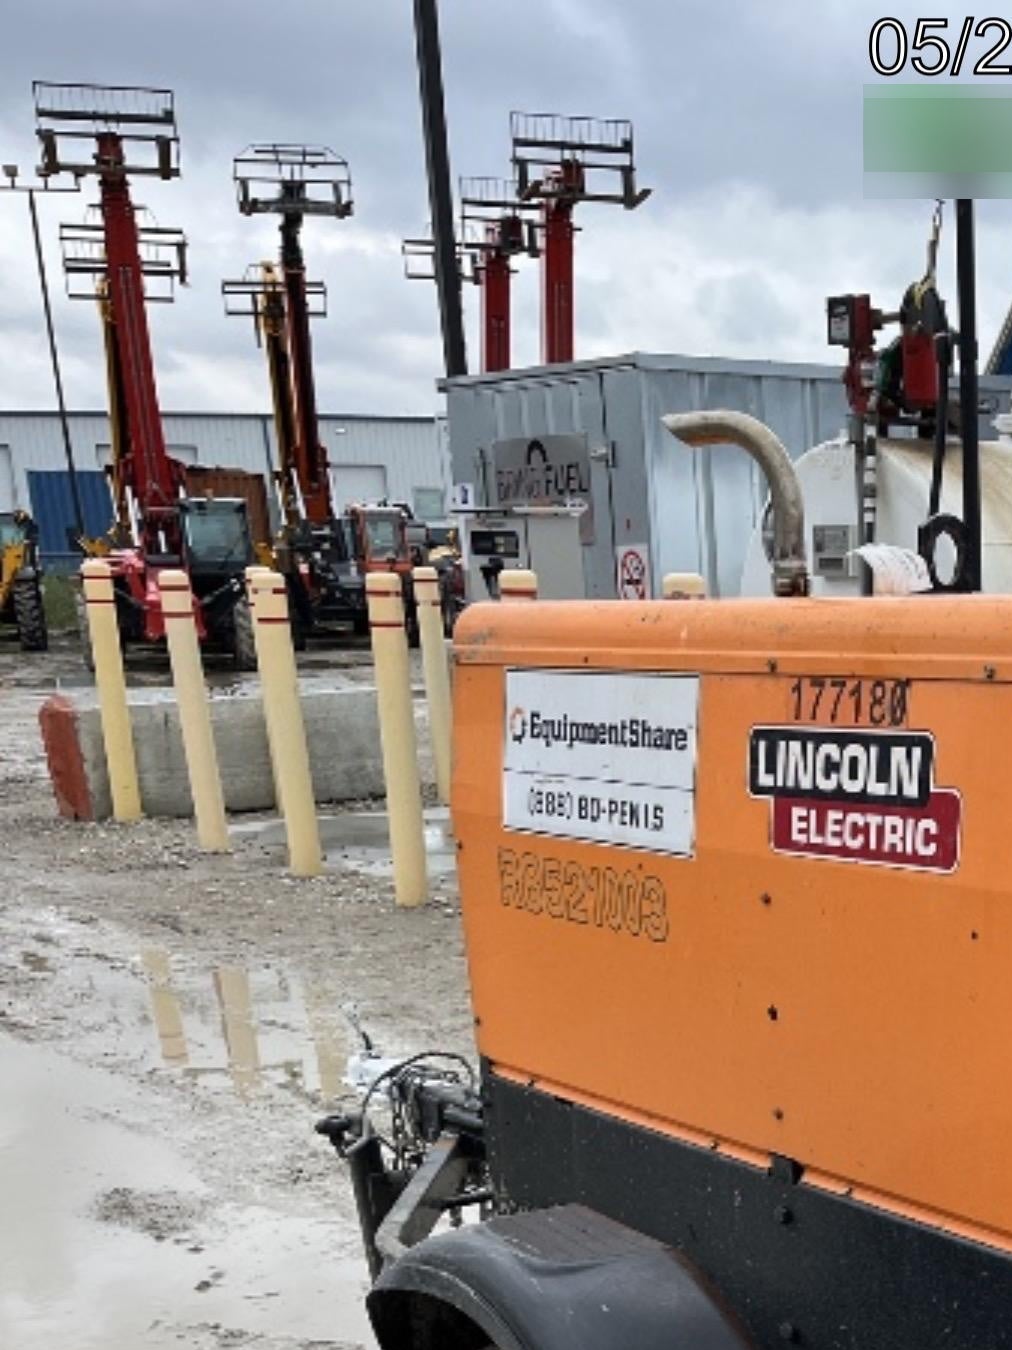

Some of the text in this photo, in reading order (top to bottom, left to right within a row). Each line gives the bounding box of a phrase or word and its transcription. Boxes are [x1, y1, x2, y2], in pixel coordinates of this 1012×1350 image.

[529, 711, 688, 751] EquipmentShare
[757, 739, 923, 799] LINCOLN
[790, 806, 939, 857] ELECTRIC
